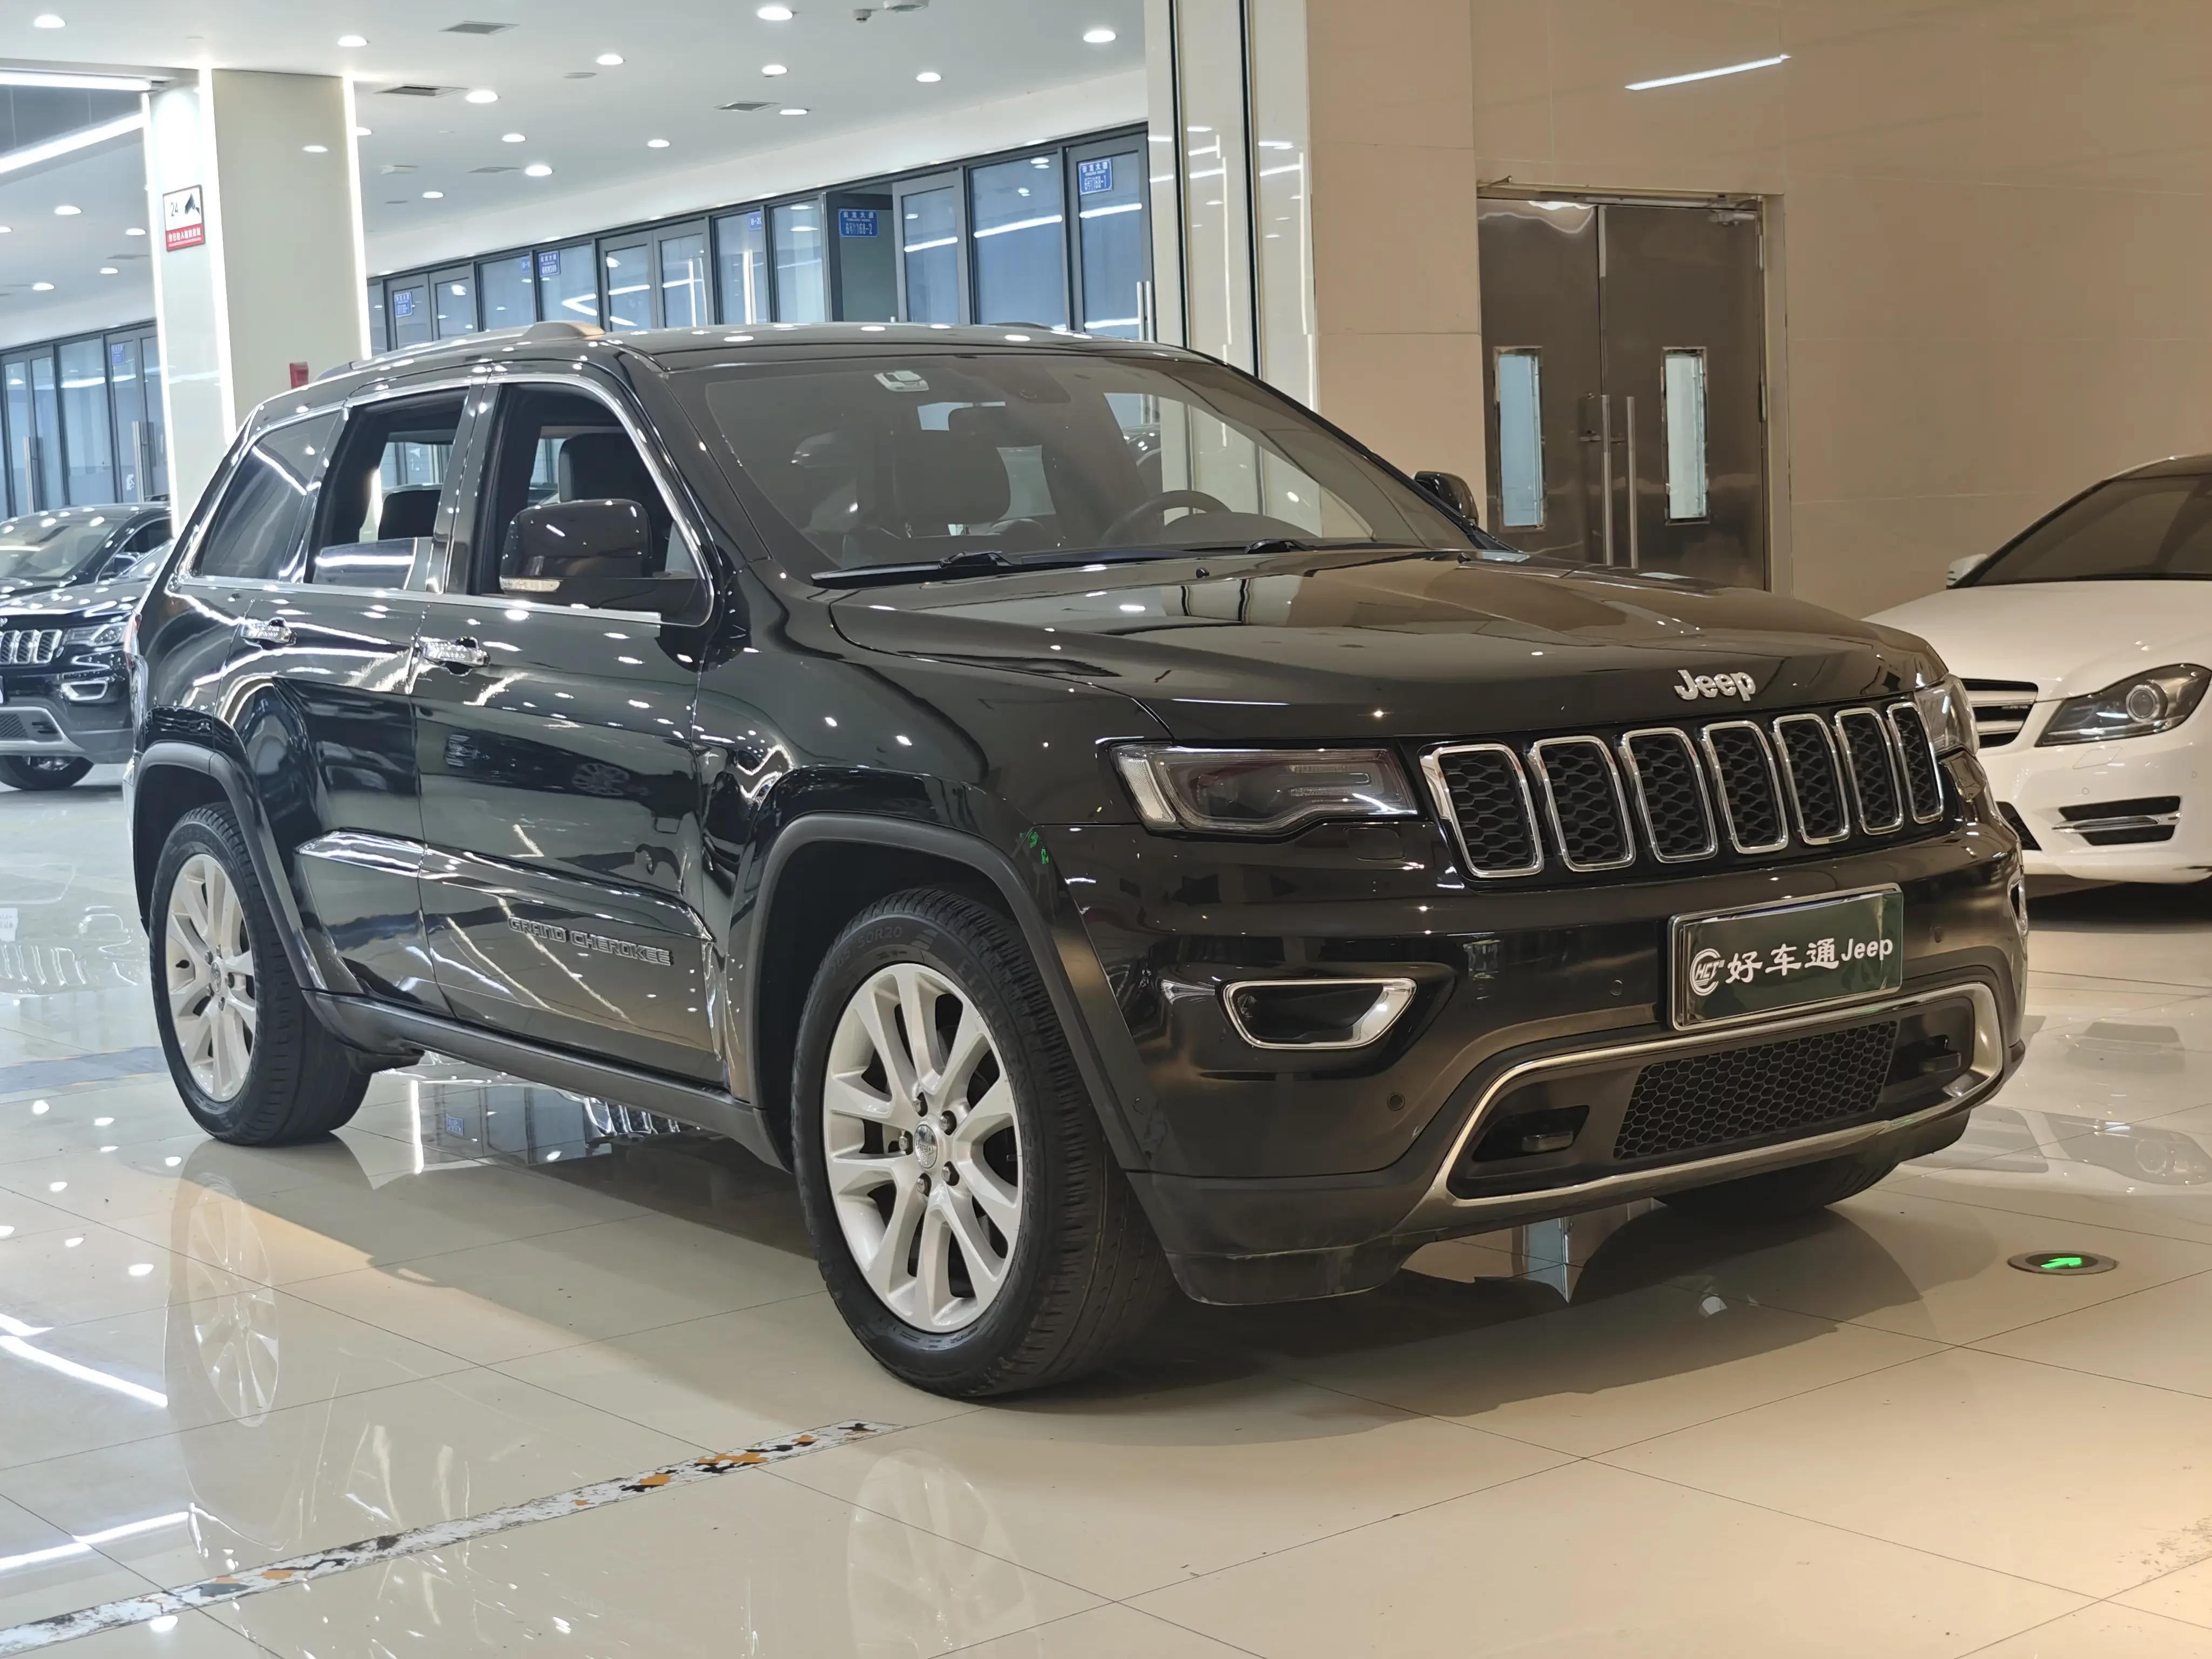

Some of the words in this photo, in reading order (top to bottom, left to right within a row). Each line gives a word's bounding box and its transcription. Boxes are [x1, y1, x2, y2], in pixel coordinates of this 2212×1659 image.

[1674, 669, 1756, 702] Jeep
[509, 916, 567, 943] GRAND
[570, 930, 671, 966] CHEROKEE
